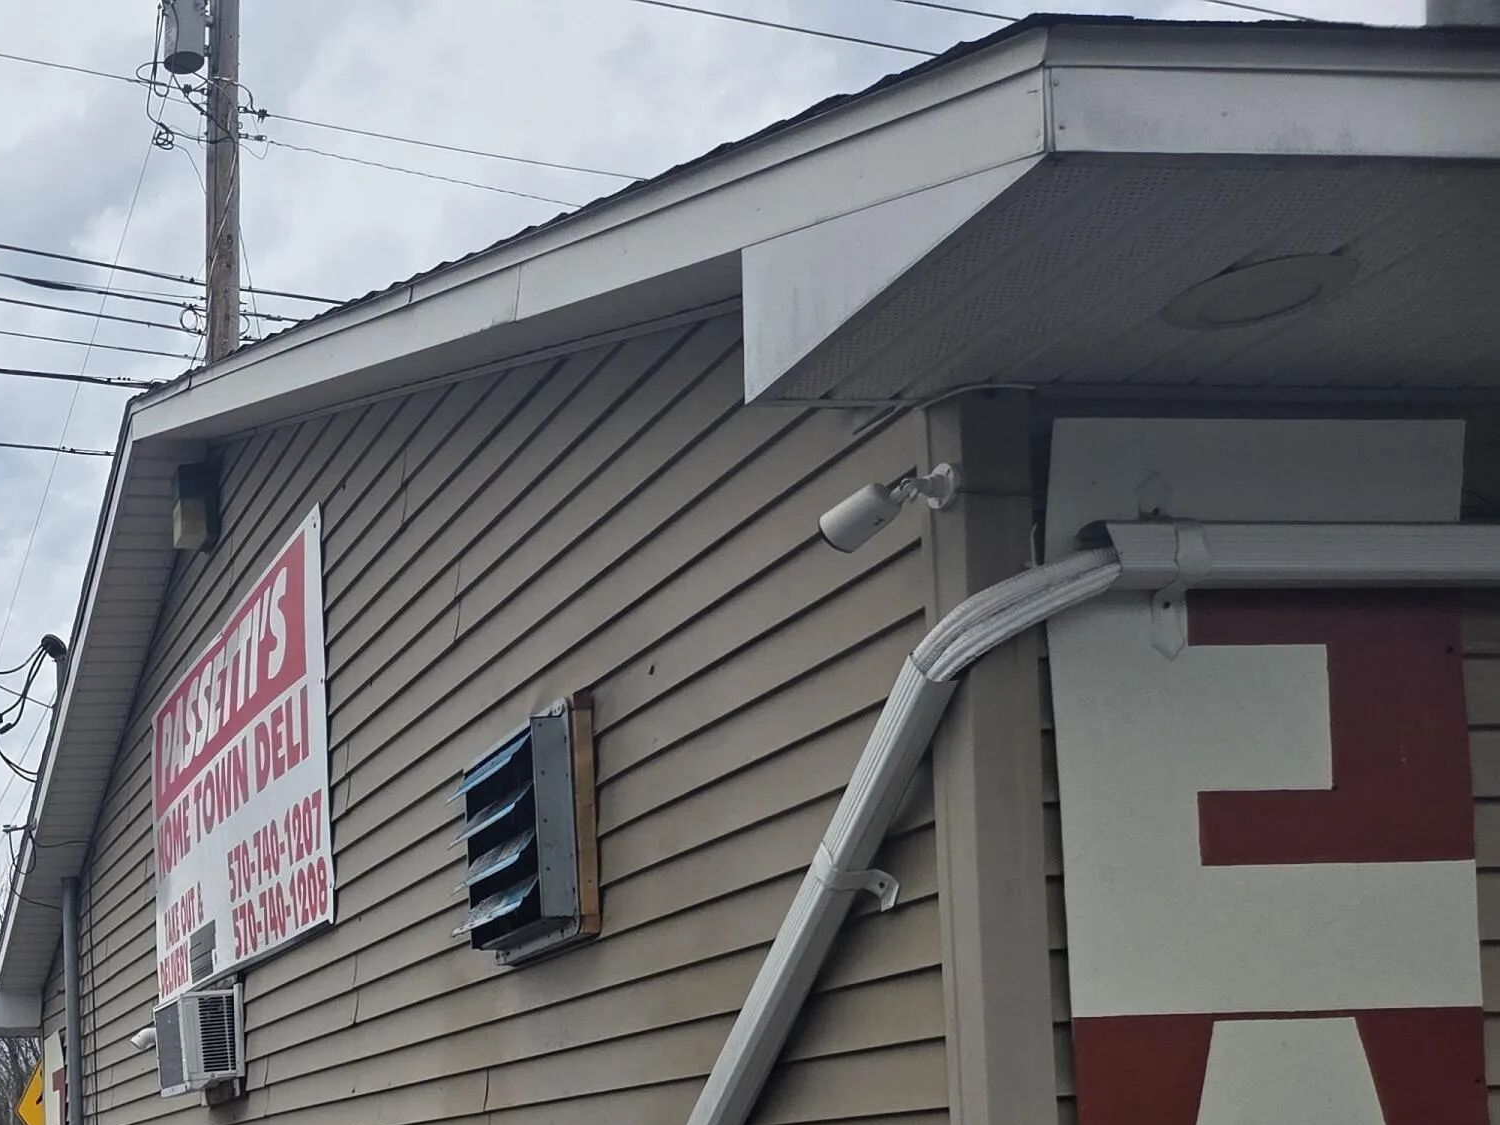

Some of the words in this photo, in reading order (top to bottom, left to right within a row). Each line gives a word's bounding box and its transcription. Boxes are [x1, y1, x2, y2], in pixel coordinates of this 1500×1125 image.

[161, 566, 288, 796] PASSETTI'S
[157, 793, 191, 882] HOME
[193, 735, 250, 844] TOWN
[254, 684, 310, 794] DELI
[227, 788, 322, 903] 570-740-1207
[164, 901, 181, 951] TAKE
[180, 886, 196, 937] OUT
[232, 856, 328, 960] 570-740-1208
[159, 940, 189, 999] DELIVERY
